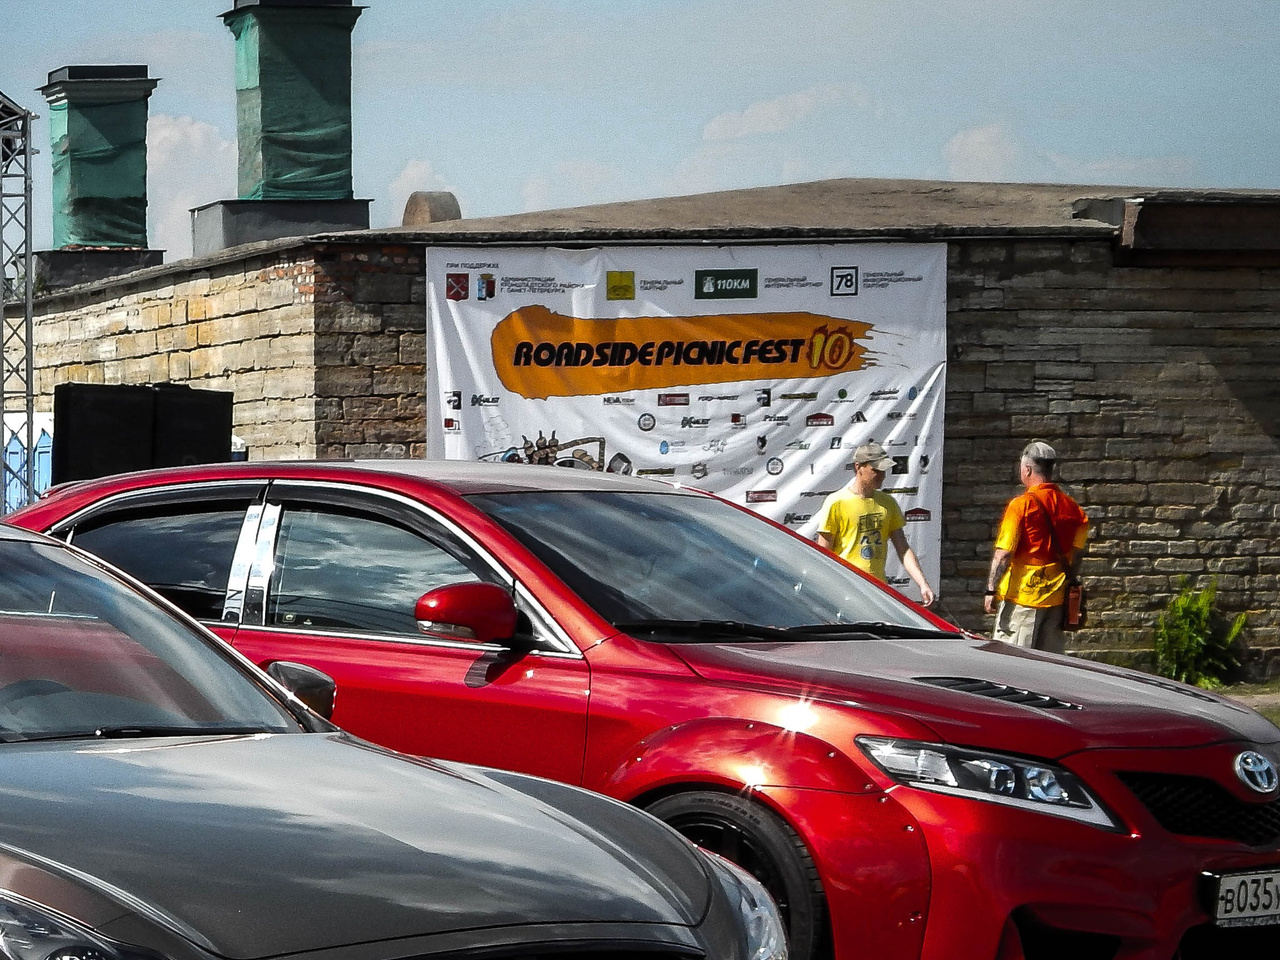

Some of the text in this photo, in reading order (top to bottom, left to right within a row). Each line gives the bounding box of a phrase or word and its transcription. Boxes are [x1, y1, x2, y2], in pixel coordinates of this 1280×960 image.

[835, 273, 854, 290] 78
[810, 332, 852, 369] 10
[1224, 876, 1280, 914] B035
